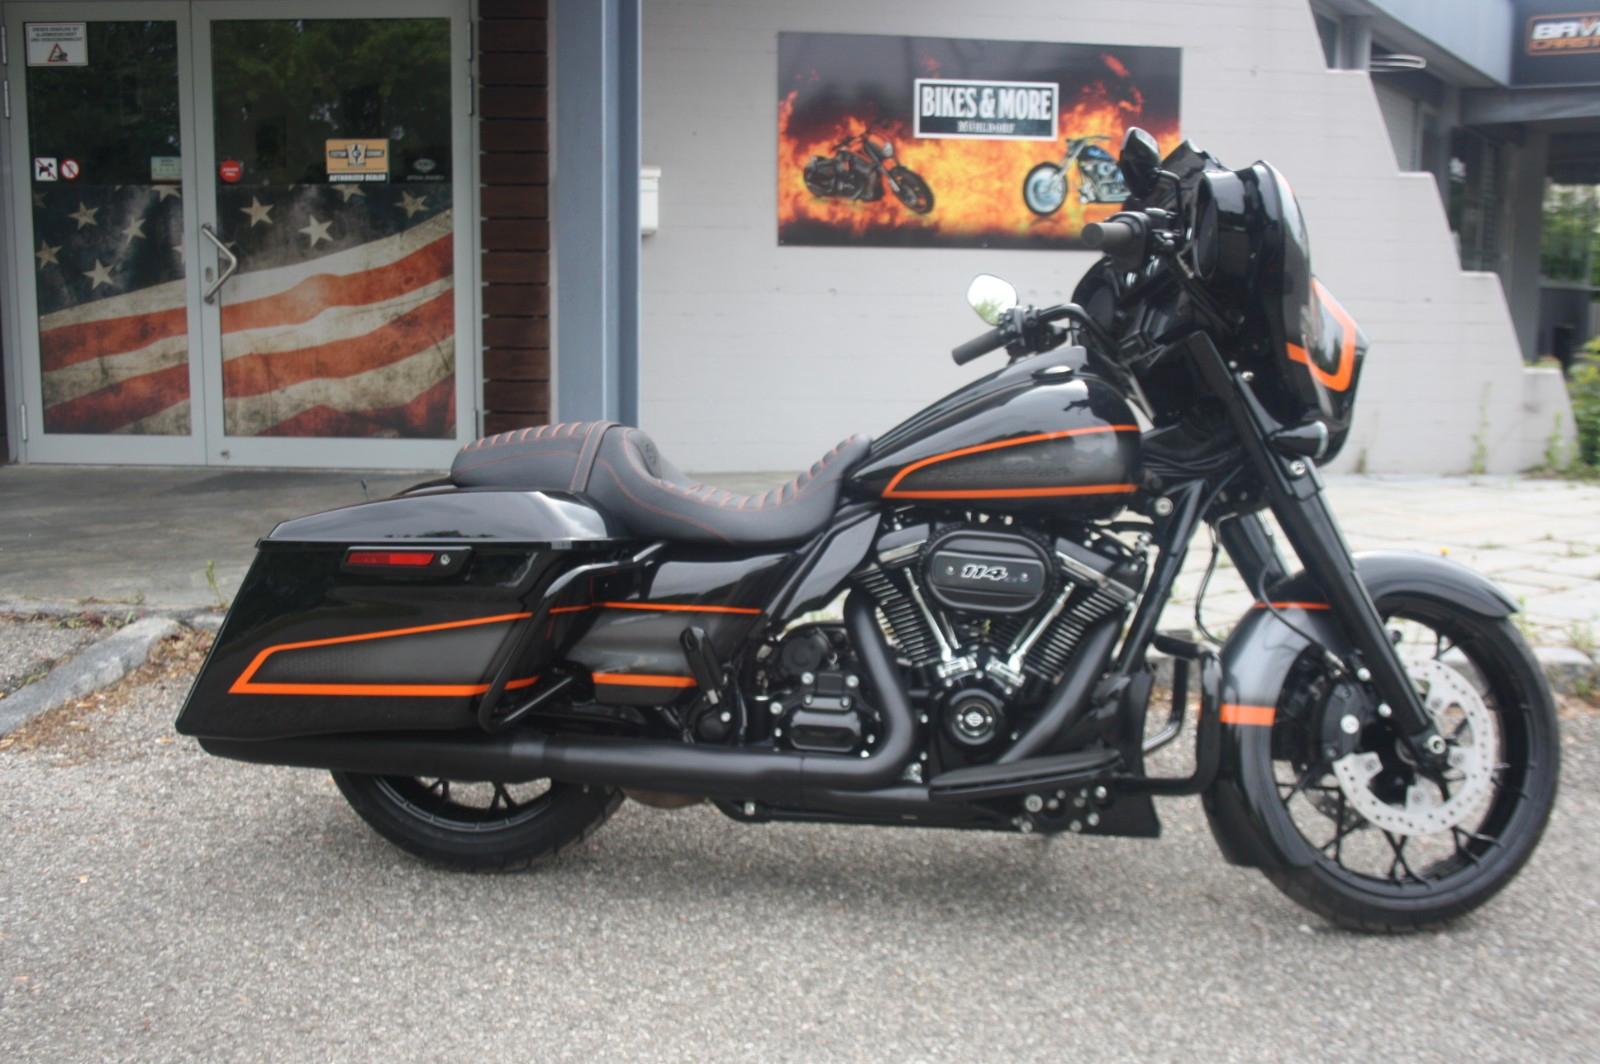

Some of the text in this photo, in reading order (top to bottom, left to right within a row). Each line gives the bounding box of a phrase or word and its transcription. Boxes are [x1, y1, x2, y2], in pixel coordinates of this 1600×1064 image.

[921, 86, 1052, 121] BIKES & MORE
[960, 563, 1008, 581] 114
